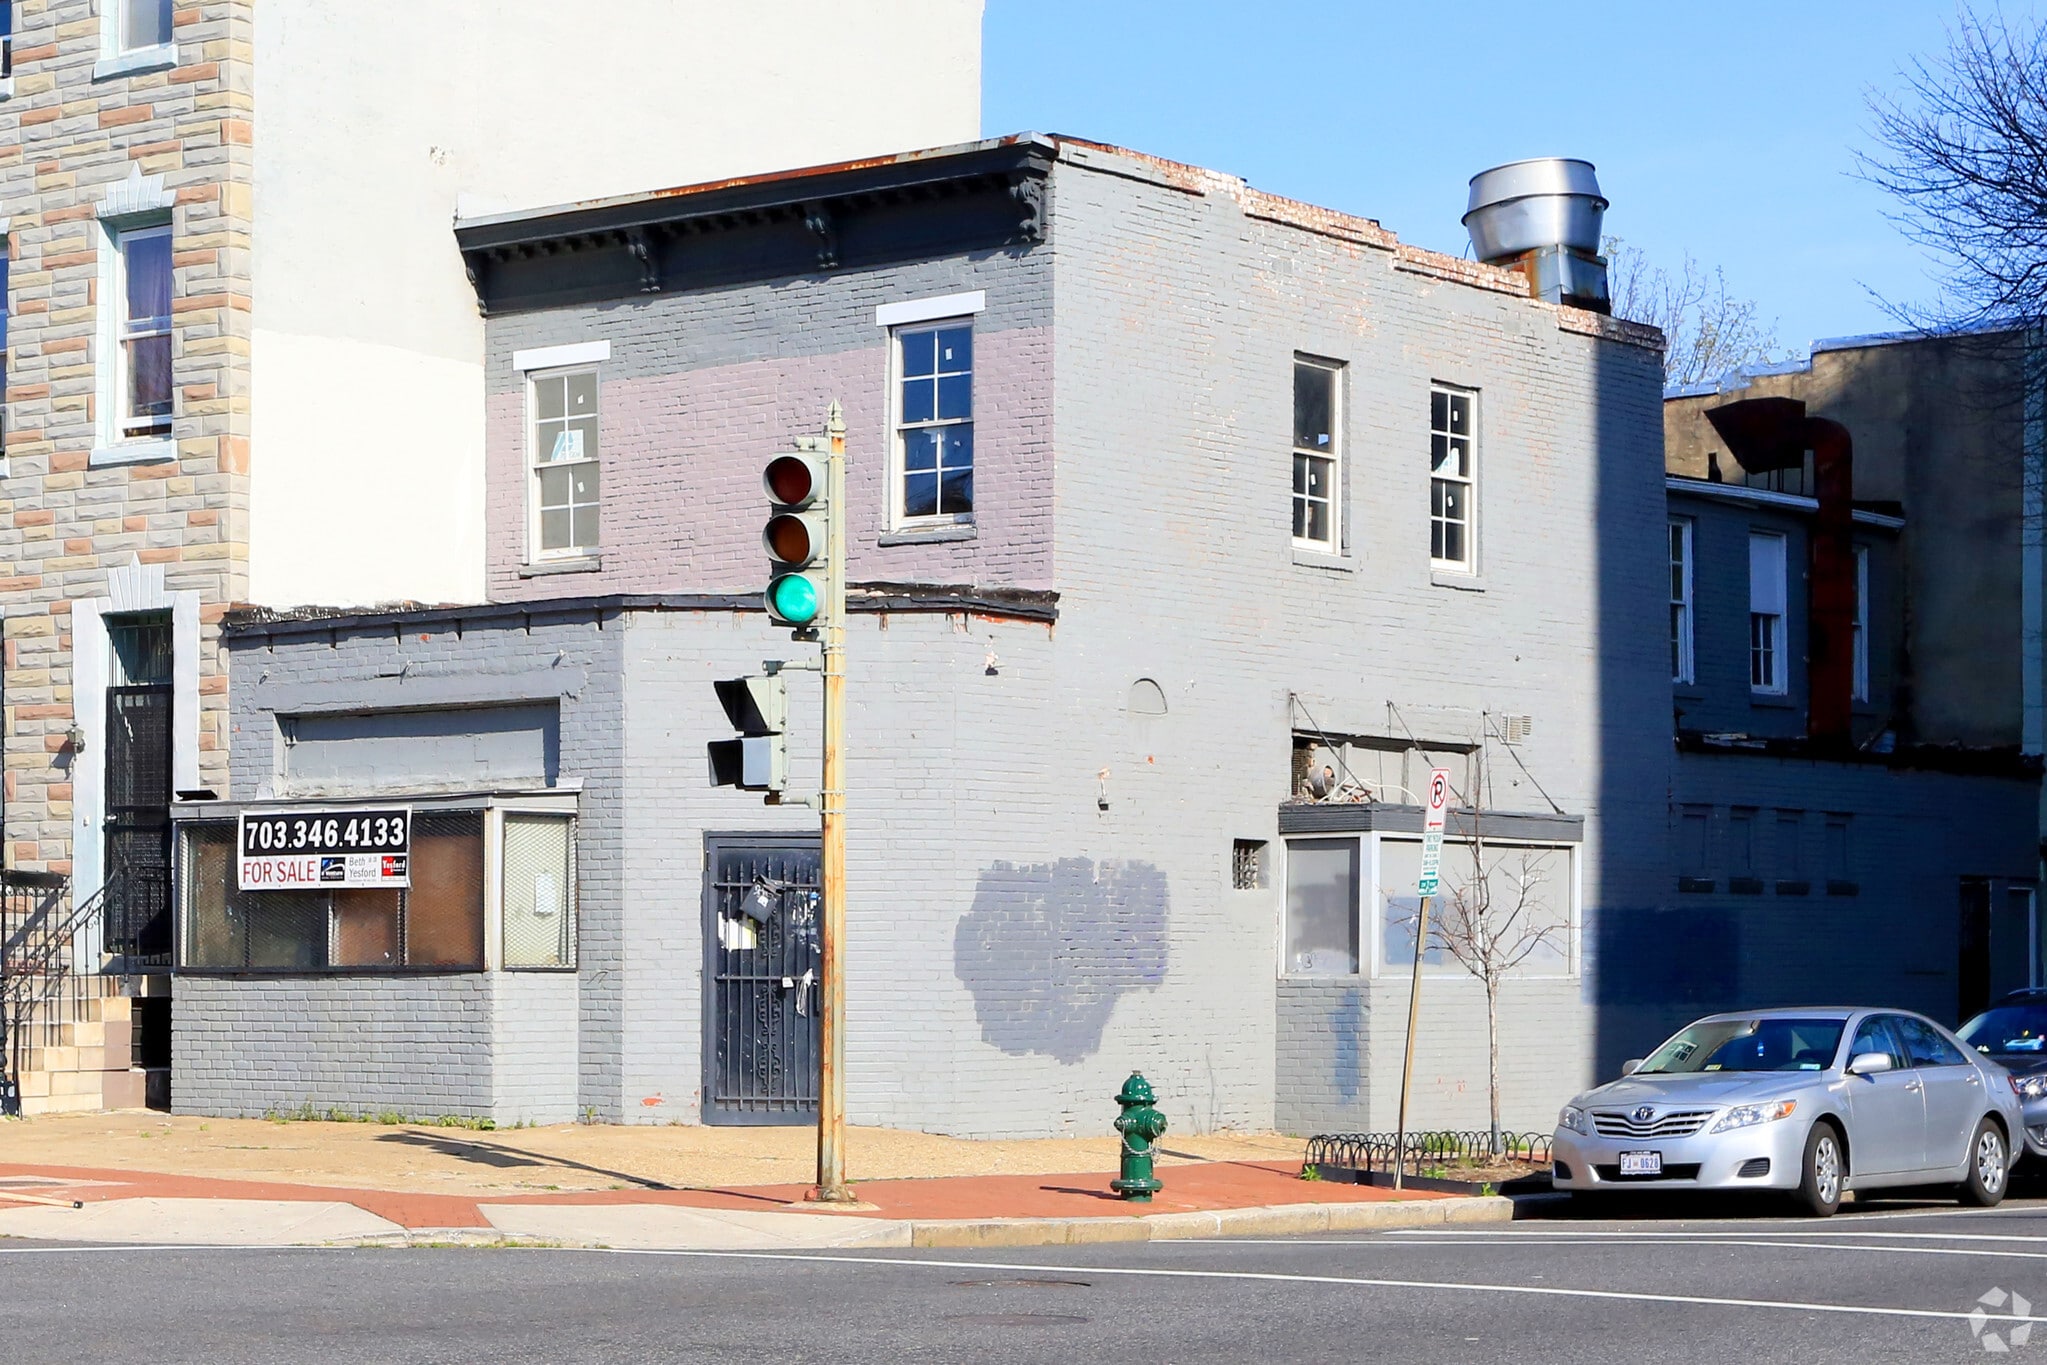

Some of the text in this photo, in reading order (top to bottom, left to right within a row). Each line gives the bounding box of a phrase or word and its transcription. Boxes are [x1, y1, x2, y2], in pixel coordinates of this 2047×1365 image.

[1433, 781, 1443, 803] P
[246, 817, 405, 850] 703.346.4133
[243, 860, 316, 883] FOR SALE
[349, 857, 366, 866] Beth
[349, 866, 376, 878] Yesford
